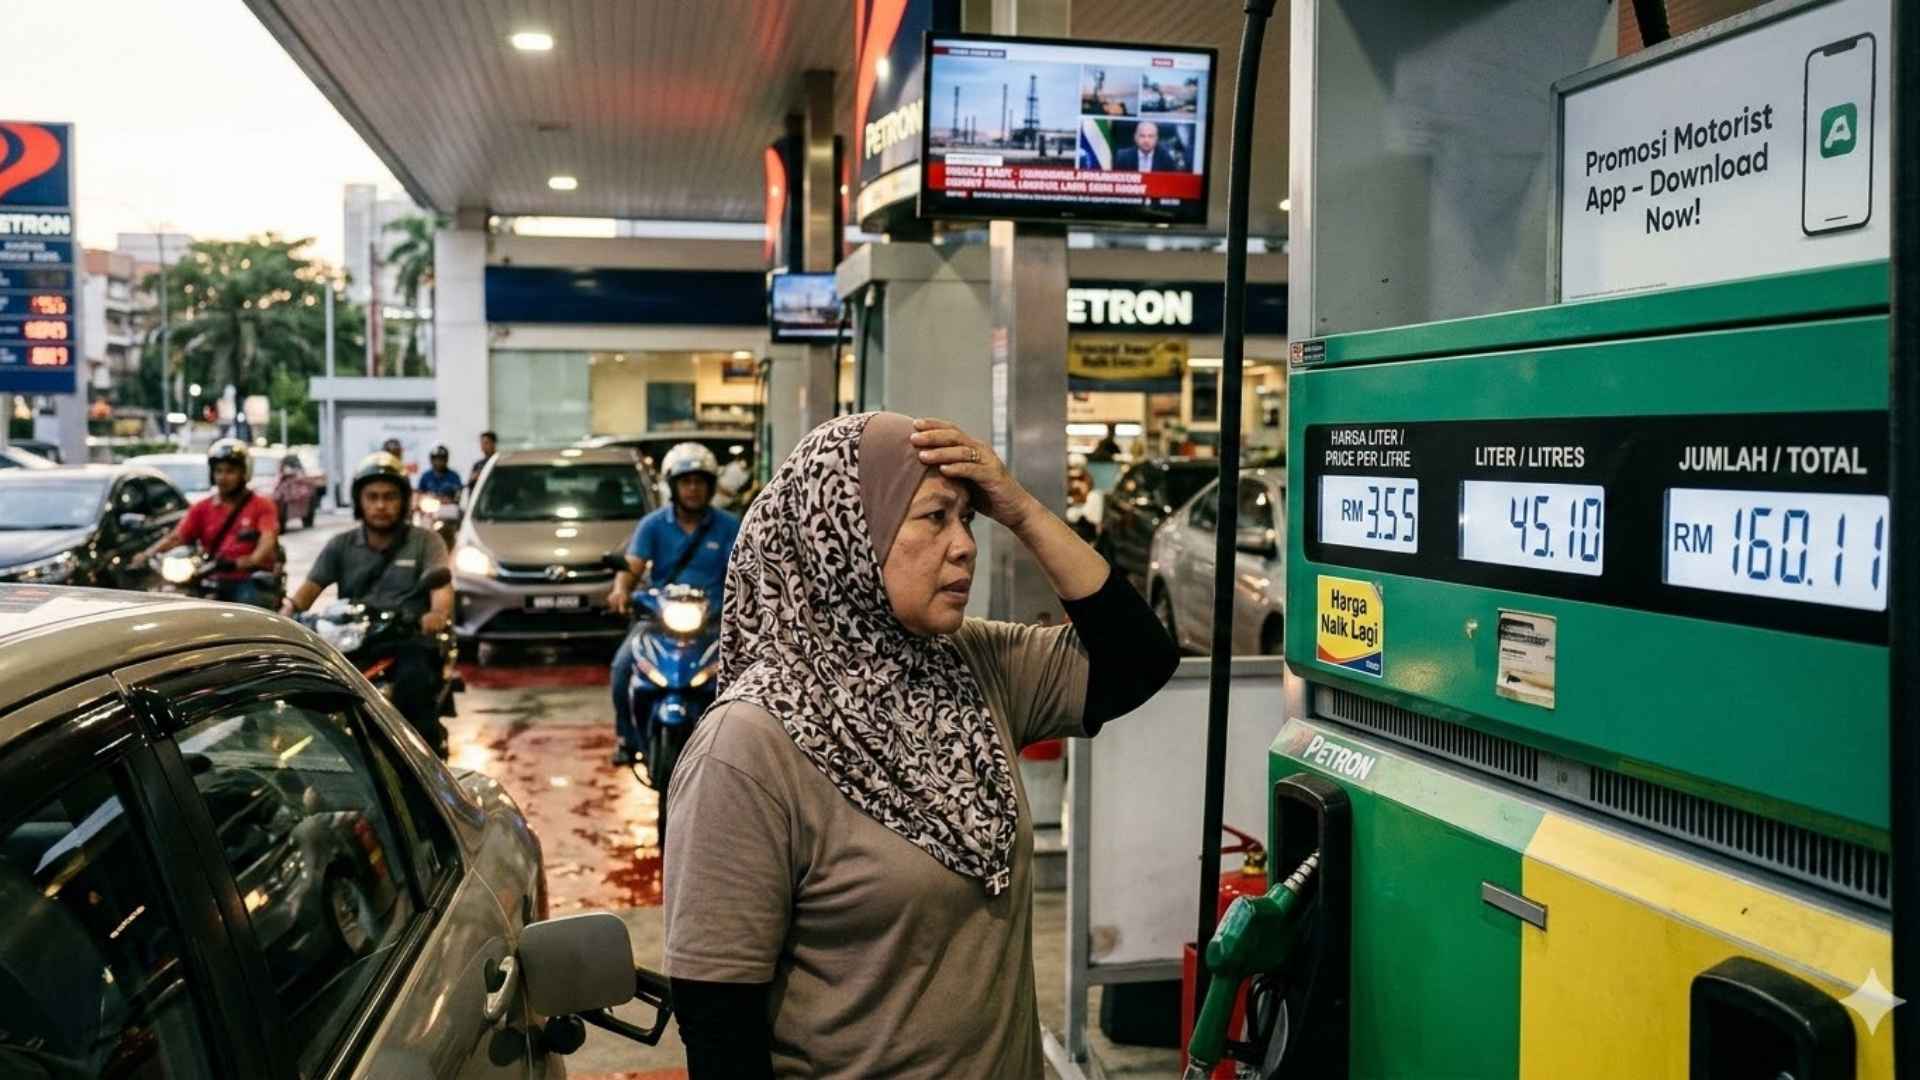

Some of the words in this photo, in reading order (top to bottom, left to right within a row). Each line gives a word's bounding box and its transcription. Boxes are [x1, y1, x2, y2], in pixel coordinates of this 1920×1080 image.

[865, 99, 922, 160] PETRON
[1585, 130, 1667, 177] Promosi
[1674, 104, 1773, 154] Motorist
[1585, 186, 1626, 214] App
[1650, 142, 1769, 197] Download
[0, 213, 70, 235] ETRON
[1646, 198, 1701, 234] Now!
[1066, 288, 1193, 325] ETRON
[1368, 429, 1398, 446] LITER
[1356, 450, 1378, 467] PER
[1475, 447, 1515, 467] LITER
[1518, 446, 1525, 467] /
[1529, 447, 1585, 468] LITRES
[1678, 446, 1767, 473] JUMLAH
[1773, 446, 1781, 473] /
[1787, 446, 1868, 475] TOTAL
[1341, 499, 1363, 522] RM
[1366, 486, 1416, 542] 3.55
[1511, 495, 1600, 562] 45.10
[1674, 523, 1713, 554] RM
[1731, 507, 1884, 591] 160.11
[1331, 589, 1367, 618] Harga
[1351, 619, 1378, 648] Lagi
[1303, 735, 1376, 780] PETRON
